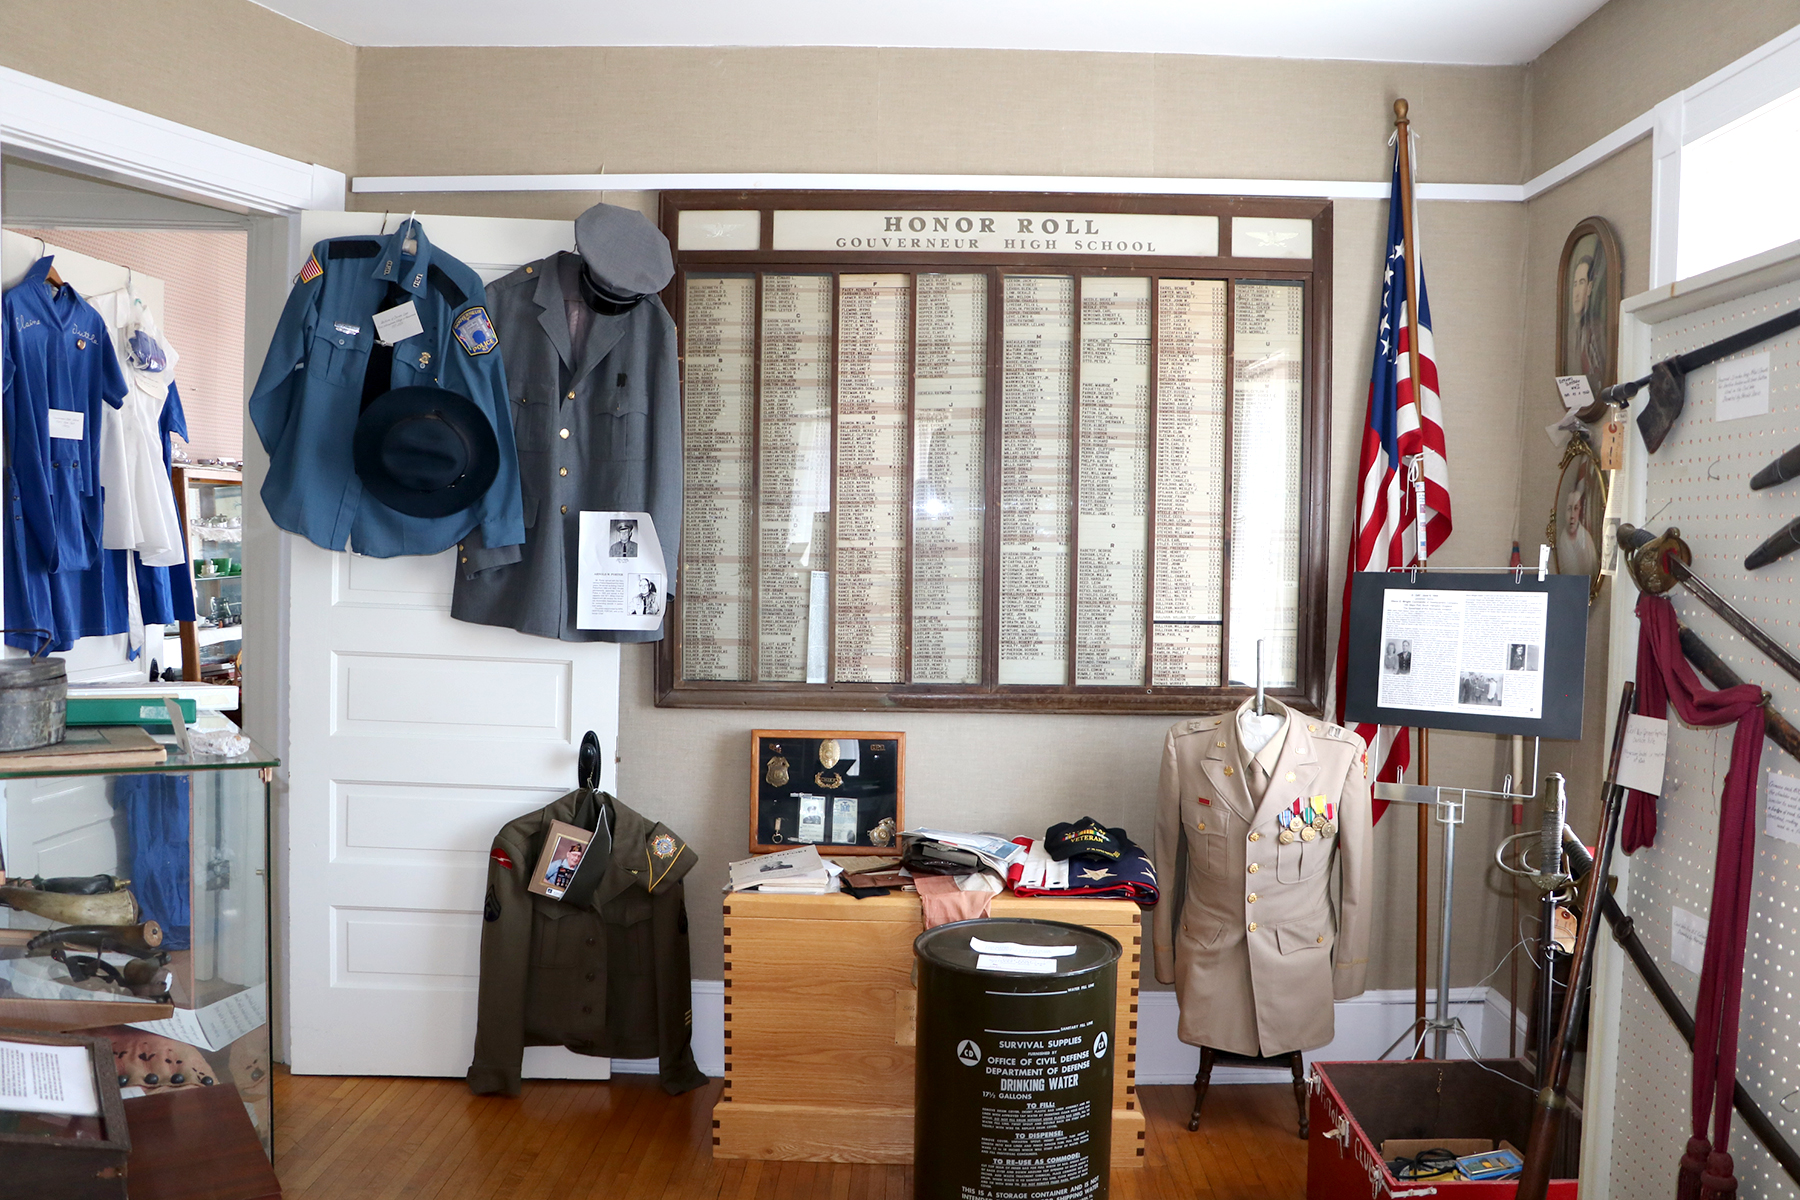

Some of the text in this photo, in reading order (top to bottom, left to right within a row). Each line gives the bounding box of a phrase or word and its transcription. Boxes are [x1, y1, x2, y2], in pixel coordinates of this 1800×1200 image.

[884, 216, 1101, 235] HONOR ROLL
[836, 236, 1157, 253] GOUVERNEUR HIGH SCHOOL
[15, 314, 99, 345] Elaine Tuttle
[472, 338, 495, 352] POLICE
[1071, 835, 1103, 843] VETERAN
[999, 1036, 1082, 1049] SURVIVAL SUPPLIES
[964, 1049, 974, 1057] CD
[987, 1050, 1090, 1066] OFFICE OF CIVIL DEFENSE
[985, 1060, 1091, 1076] DEPARTMENT OF DEFENSE
[1000, 1073, 1079, 1092] DRINKING WATER
[1028, 1130, 1064, 1139] DISPENSE:
[1046, 1152, 1081, 1164] COMMODE:
[961, 1186, 975, 1195] THIS
[978, 1188, 985, 1196] IS
[1031, 1187, 1068, 1198] CONTAINER
[1070, 1183, 1083, 1193] AND
[1090, 1175, 1100, 1185] NOT
[1084, 1183, 1099, 1195] WATER
